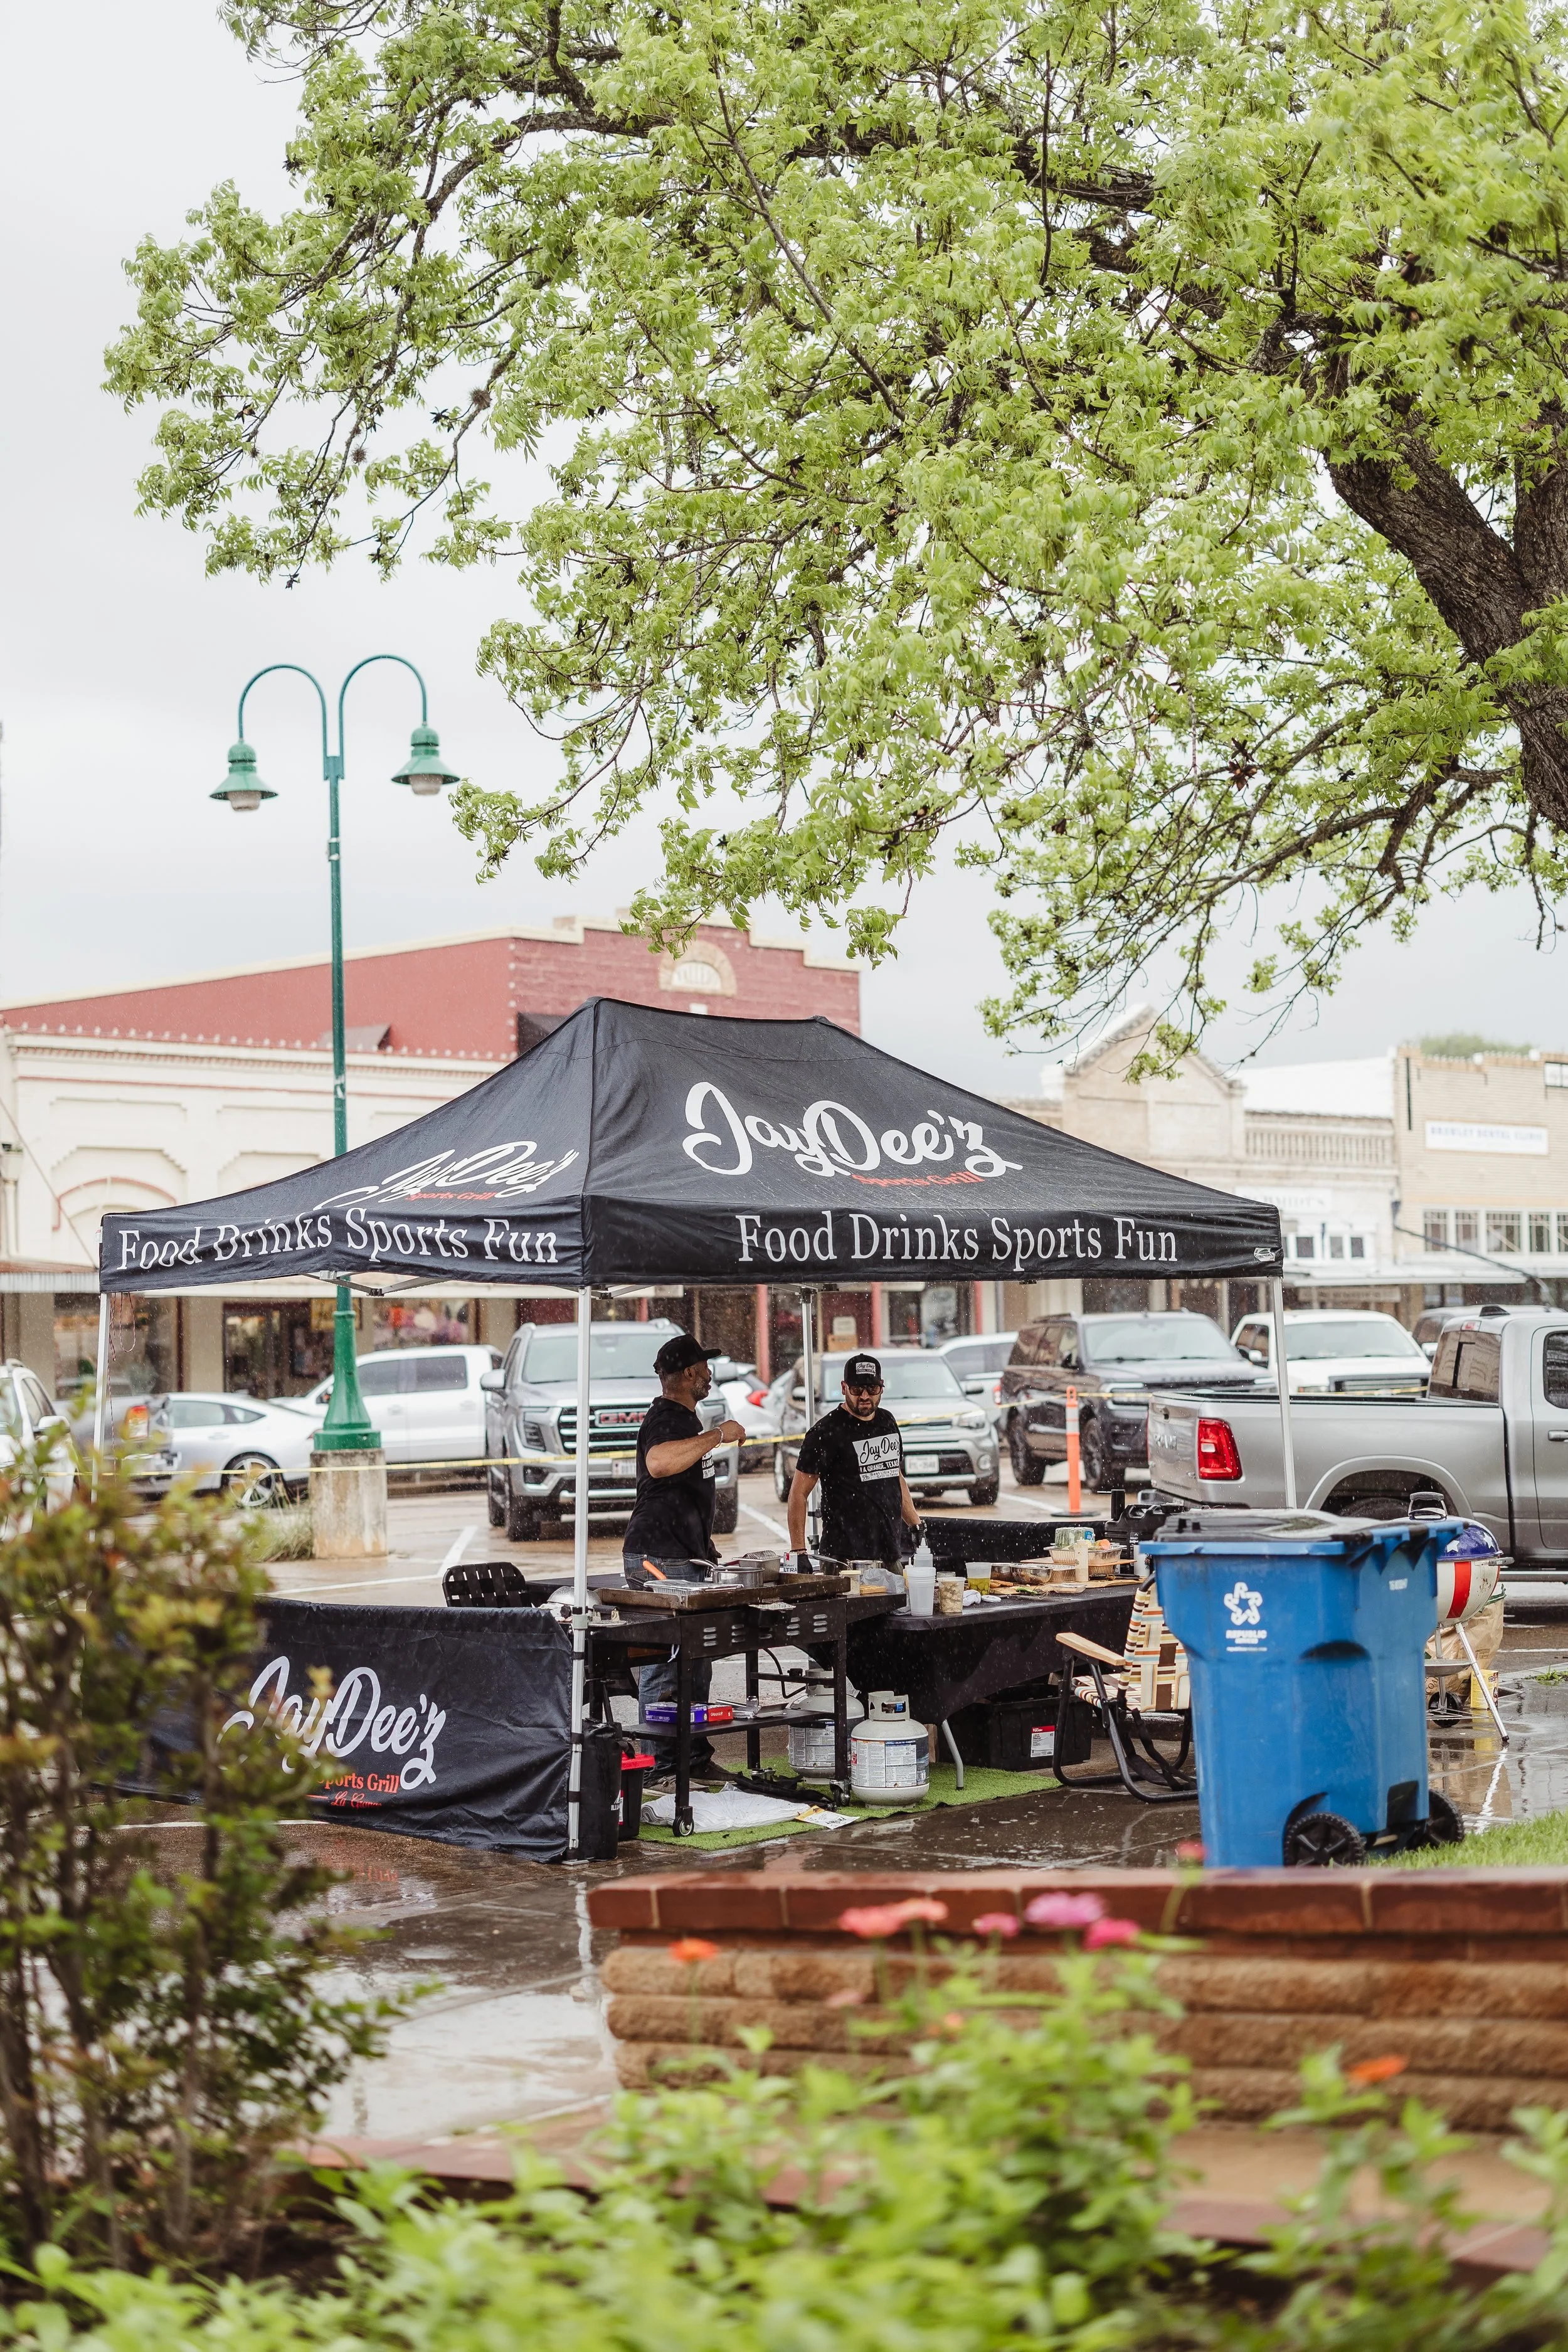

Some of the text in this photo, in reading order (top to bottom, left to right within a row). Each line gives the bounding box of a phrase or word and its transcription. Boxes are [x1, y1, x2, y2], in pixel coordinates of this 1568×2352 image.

[682, 1081, 1023, 1177] JayDee'z
[926, 1171, 985, 1185] Grill
[457, 1190, 497, 1201] Grill
[116, 1207, 558, 1270] Food Drinks Sports Fun
[735, 1210, 1178, 1272] Food Drinks Sports Fun
[860, 1440, 881, 1464] Jay
[1226, 1629, 1267, 1639] REPUBLIC
[317, 1772, 400, 1794] ports Grill
[331, 1791, 348, 1807] La
